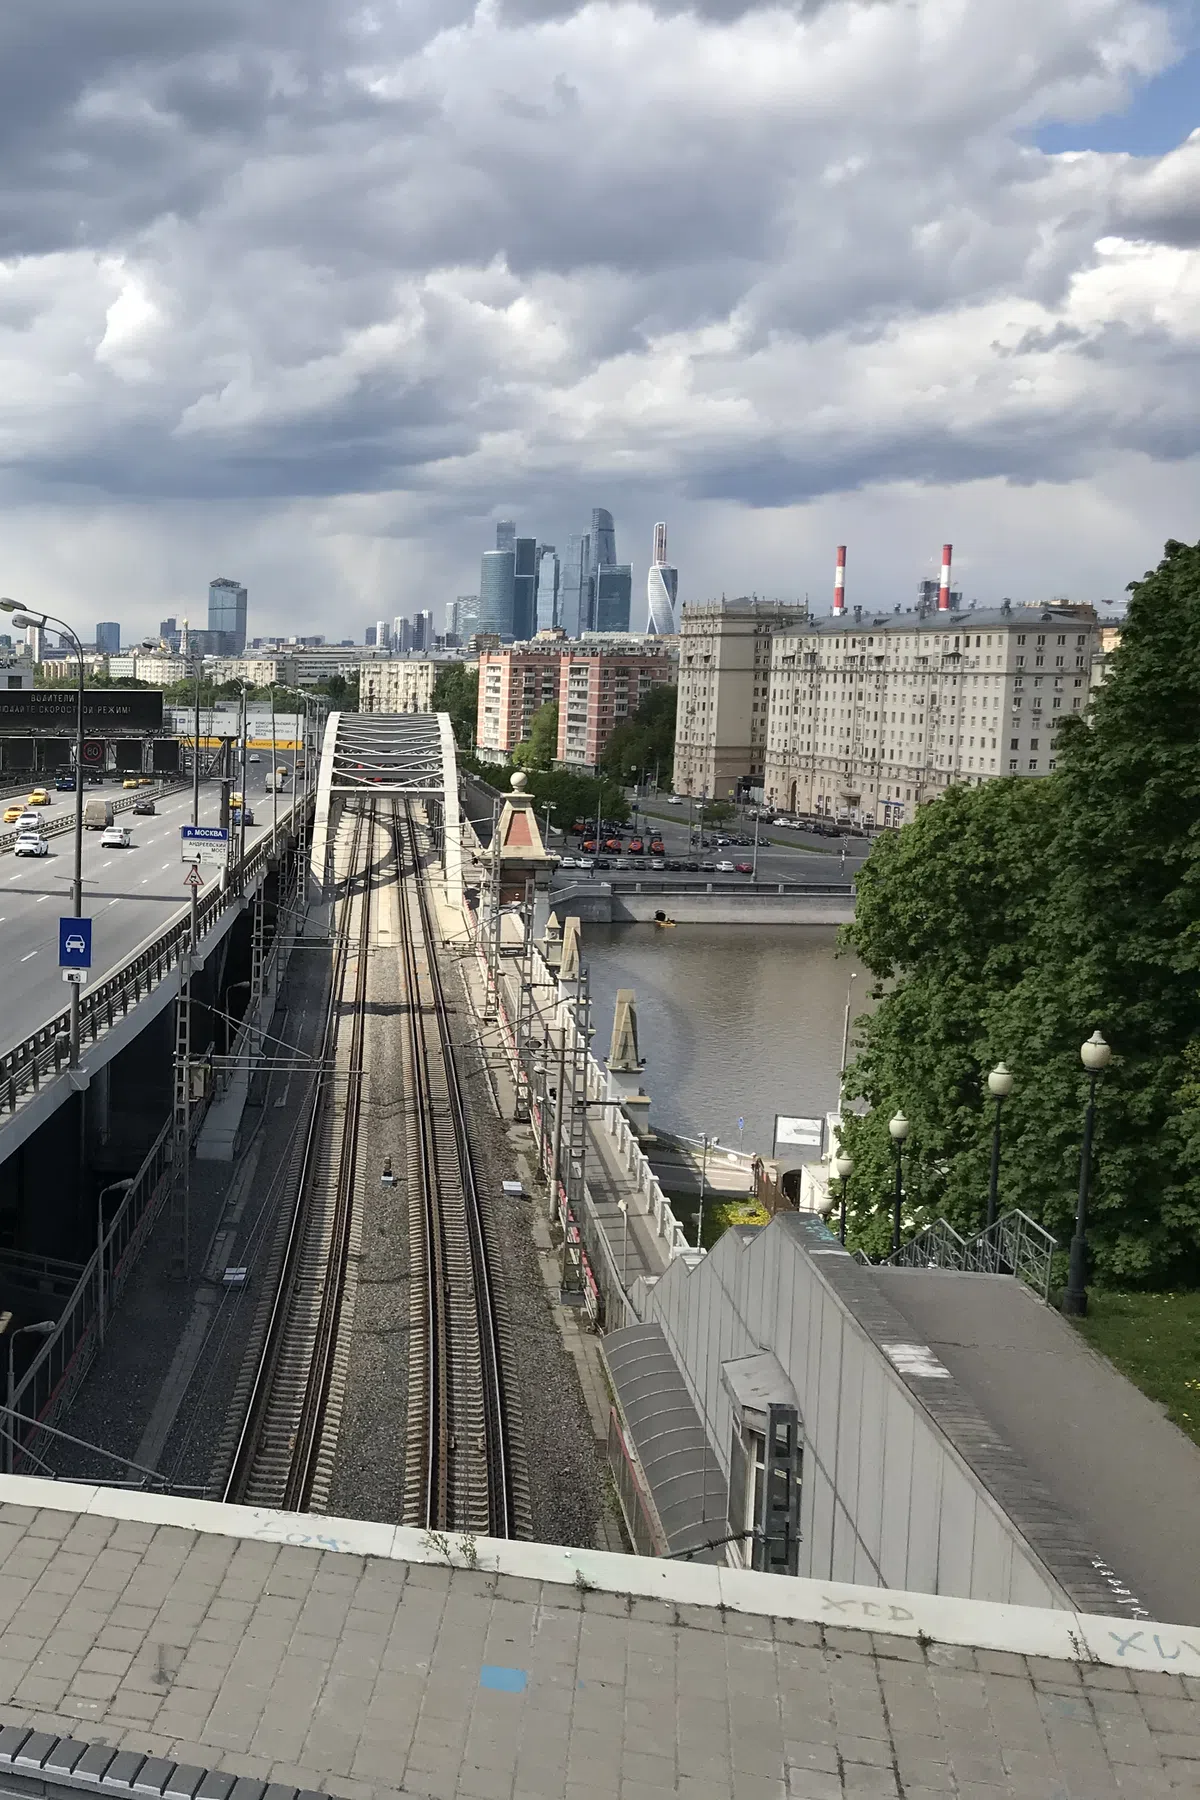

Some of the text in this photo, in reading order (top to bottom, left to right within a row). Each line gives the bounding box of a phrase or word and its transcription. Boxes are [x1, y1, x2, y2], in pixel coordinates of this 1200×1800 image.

[31, 694, 75, 703] ВОДИТЕЛИ
[39, 705, 94, 714] СКОРОСТОЙ
[87, 747, 99, 756] 80
[194, 829, 223, 837] МОСКВА
